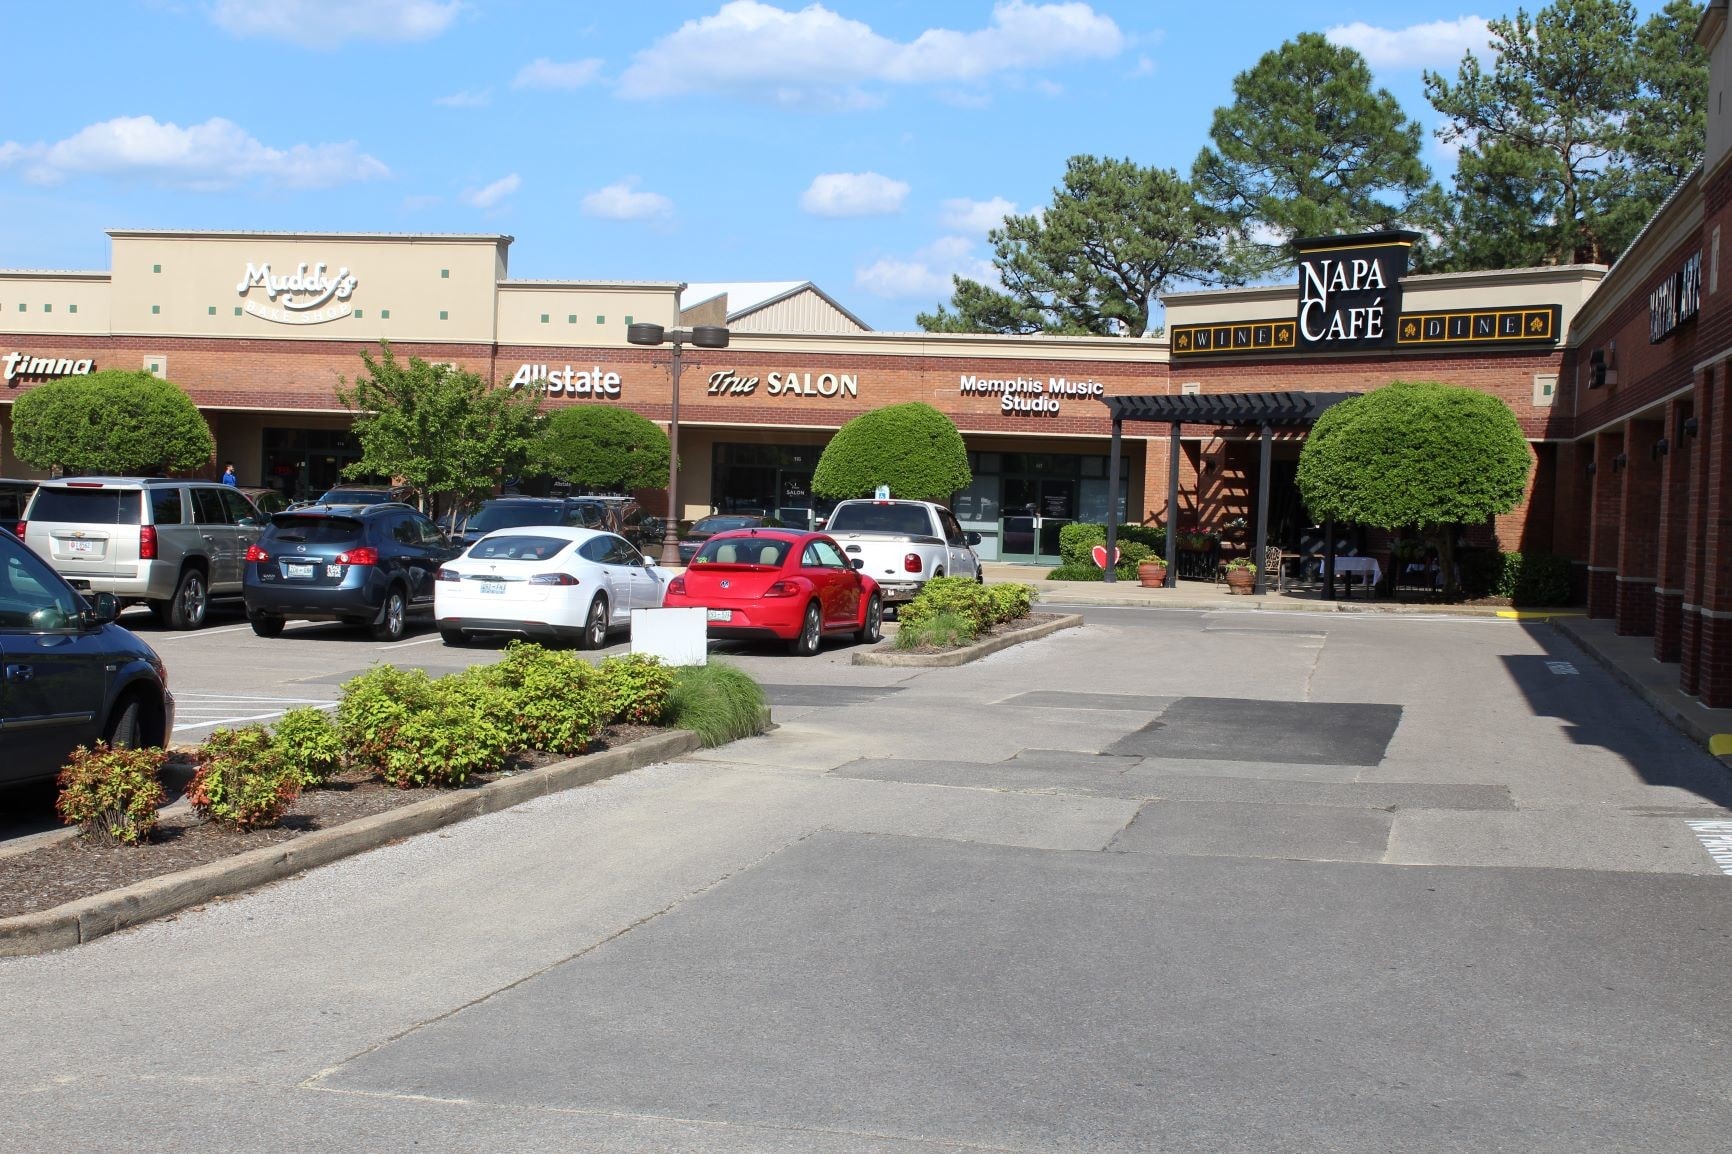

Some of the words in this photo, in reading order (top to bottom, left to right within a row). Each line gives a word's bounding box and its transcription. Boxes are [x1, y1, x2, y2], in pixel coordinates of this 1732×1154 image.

[237, 261, 357, 309] Muddy's
[1301, 258, 1386, 312] NAPA
[245, 299, 290, 322] BAKE
[303, 303, 349, 322] SHOP
[1301, 297, 1384, 341] CAFÉ
[1197, 324, 1267, 346] WINE
[1429, 316, 1515, 336] DINE
[2, 352, 93, 379] timna
[508, 364, 621, 393] Allstate
[707, 369, 759, 392] True
[767, 372, 858, 395] SALON
[960, 375, 1043, 396] Memphis
[1049, 377, 1104, 394] Music
[1001, 395, 1060, 411] Studio
